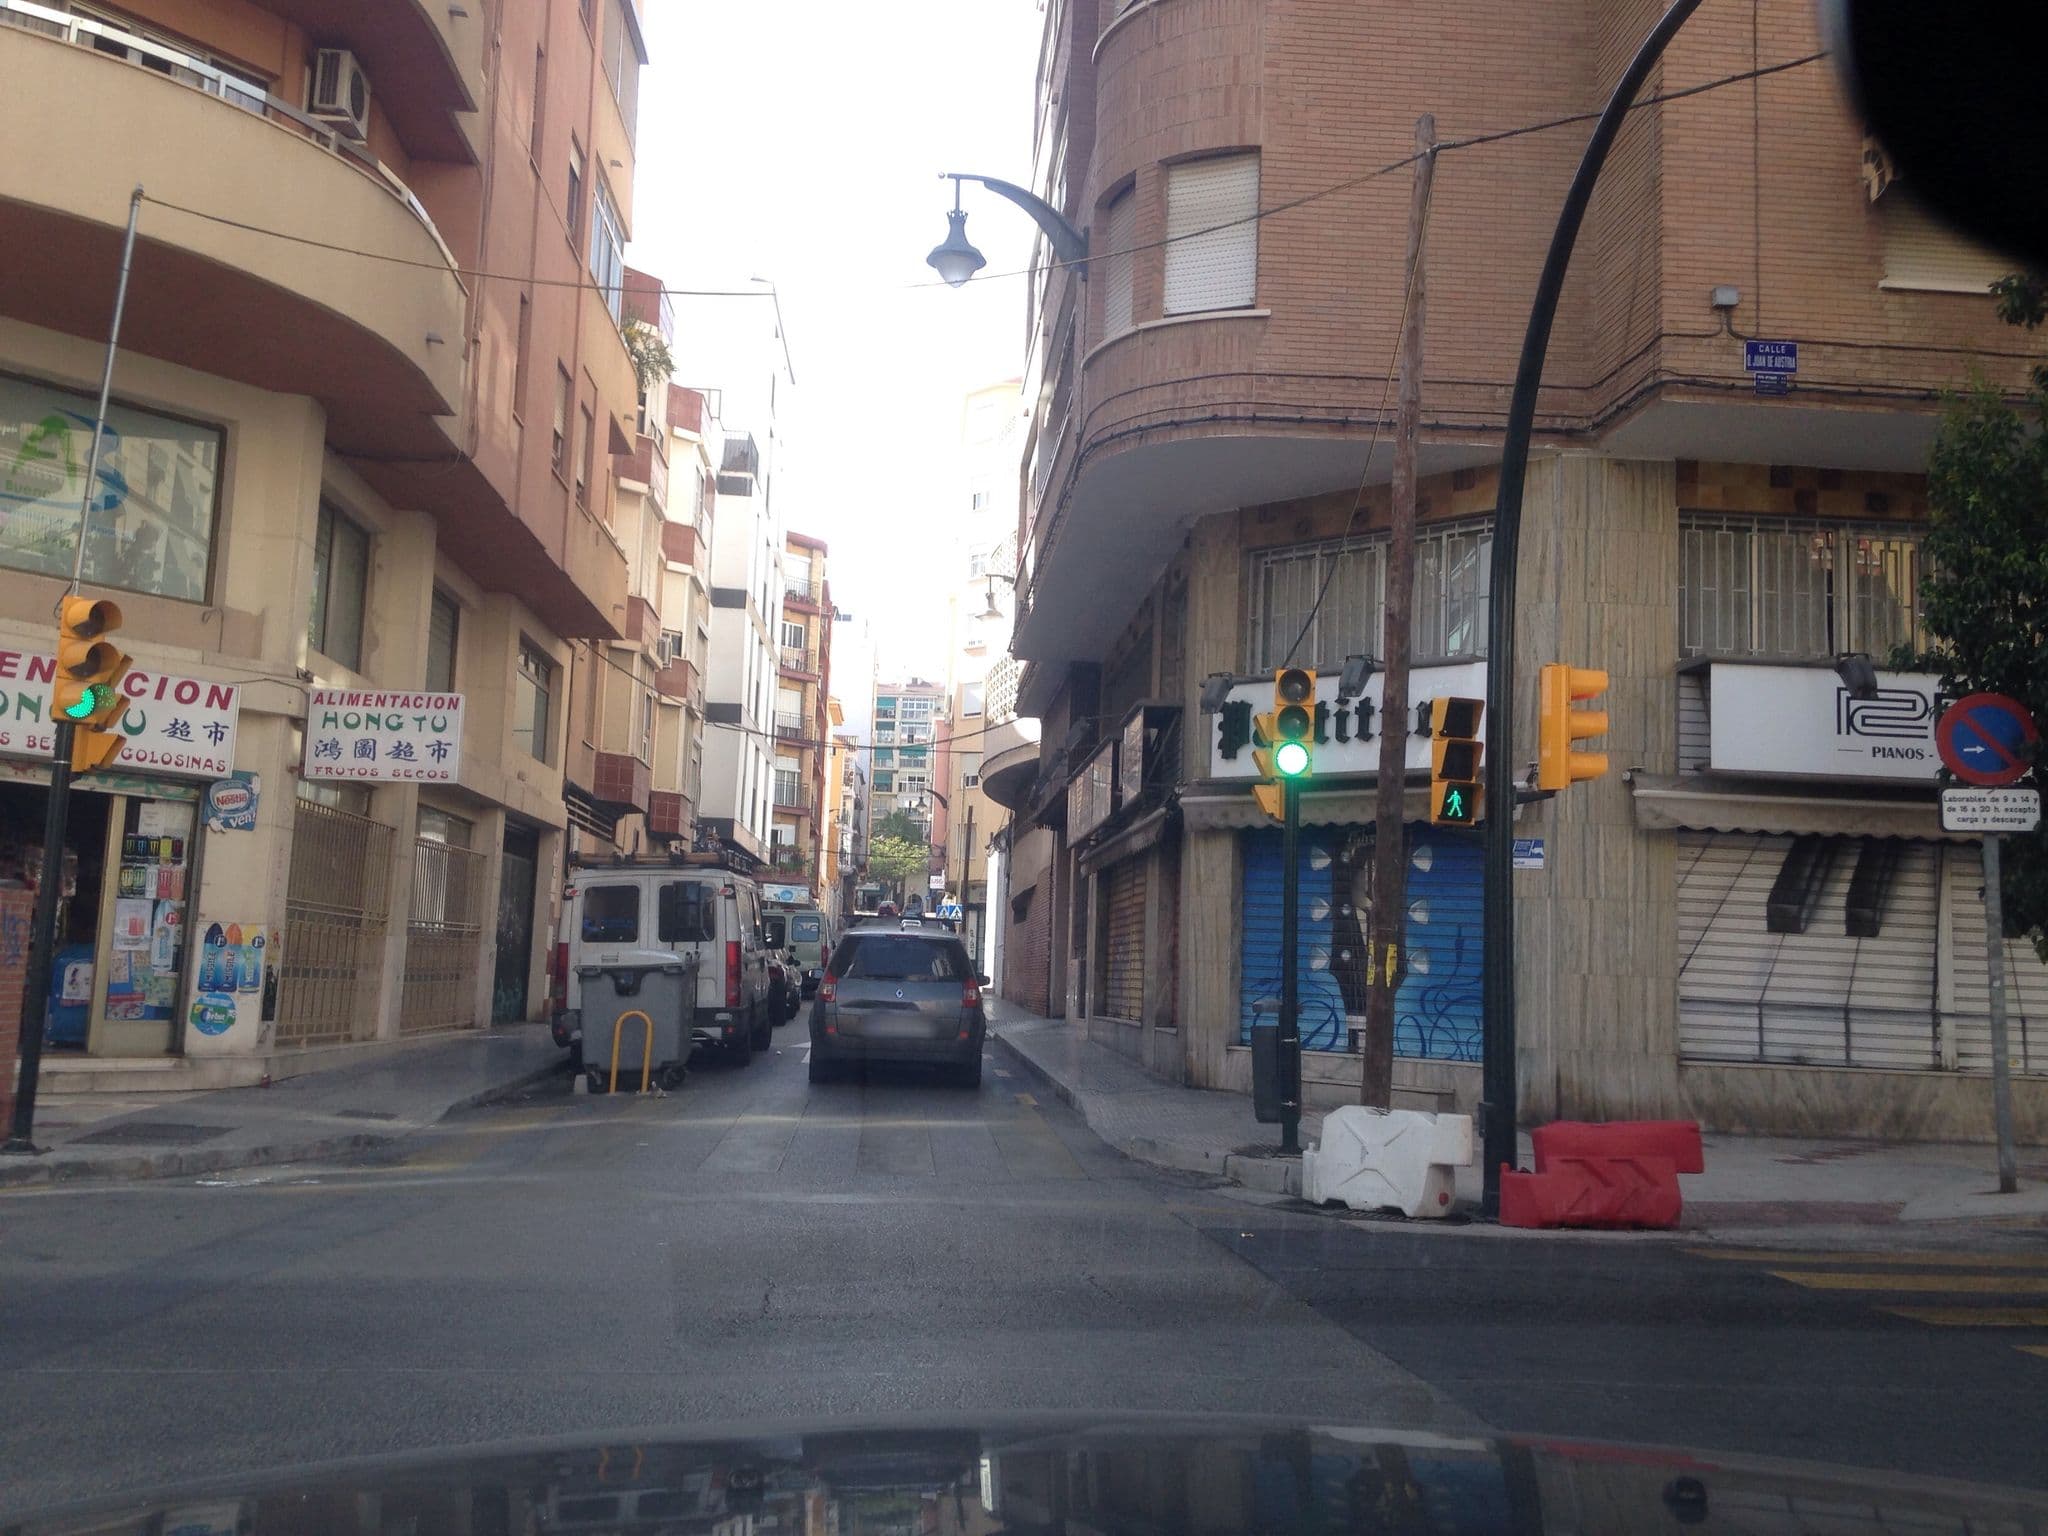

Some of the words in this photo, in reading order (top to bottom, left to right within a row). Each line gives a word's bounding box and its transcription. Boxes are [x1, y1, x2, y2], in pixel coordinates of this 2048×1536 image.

[1758, 344, 1786, 354] CALLE
[1767, 355, 1774, 368] DE
[313, 692, 460, 710] ALIMENTACION
[322, 711, 404, 732] HONG
[412, 715, 448, 733] TU
[161, 718, 230, 747] 超市
[120, 747, 227, 773] GOLOSINAS
[1872, 746, 1925, 760] PIANOS
[314, 766, 379, 777] FRUTOS
[391, 769, 449, 780] SECOS
[1943, 795, 1986, 803] Laborables
[2003, 795, 2009, 803] 9
[2004, 806, 2037, 814] excepto
[1957, 816, 1979, 824] carga
[1991, 816, 2026, 825] descarga
